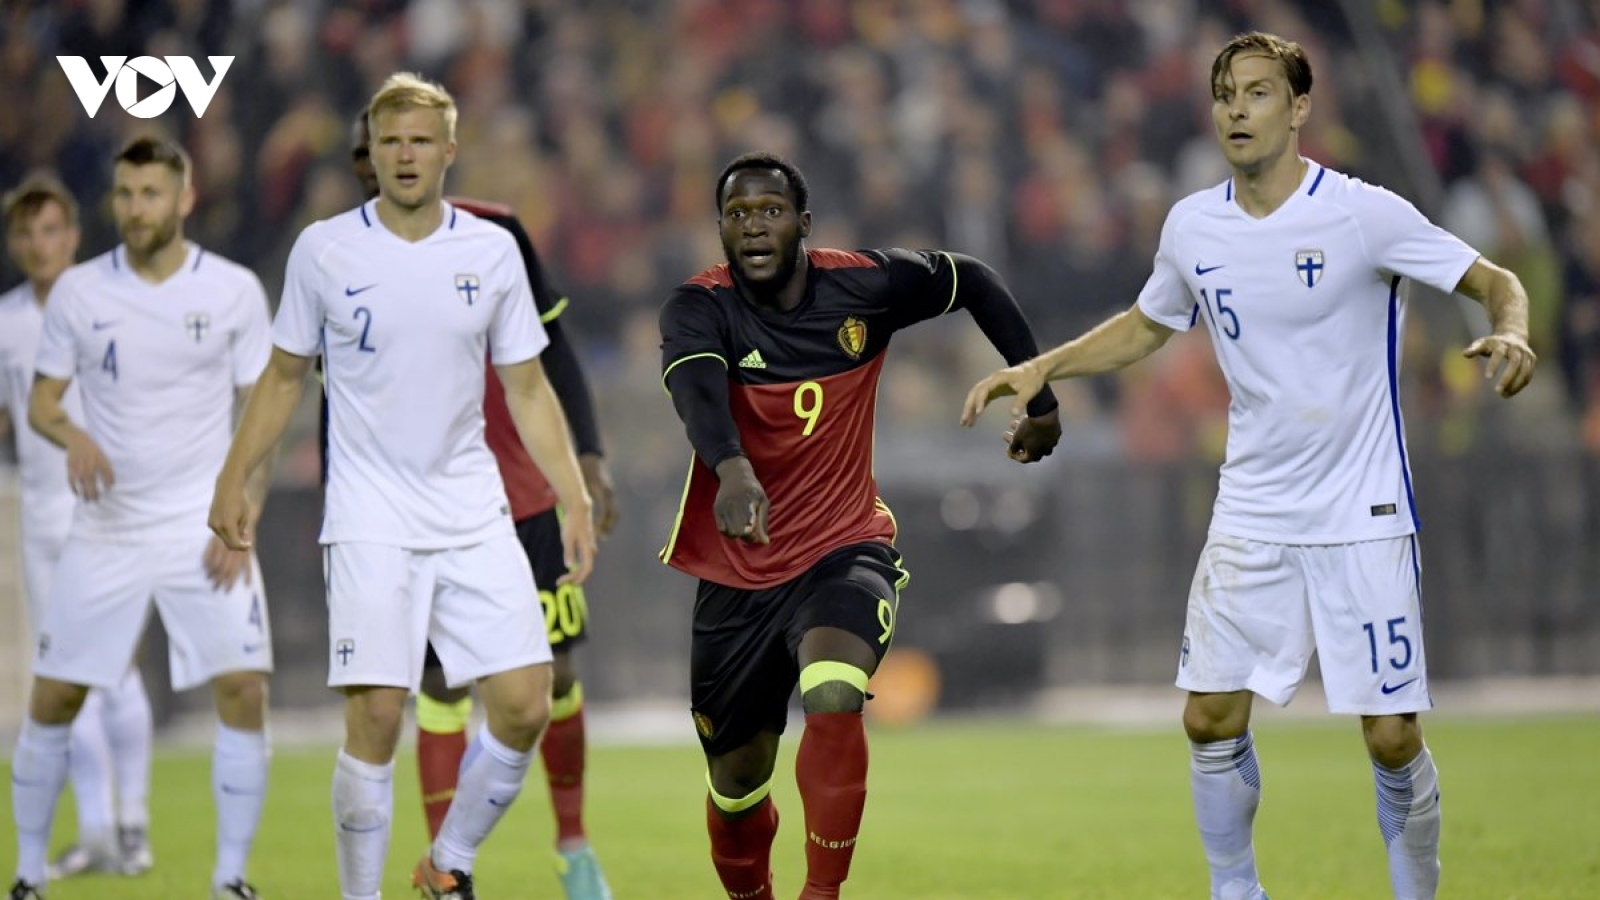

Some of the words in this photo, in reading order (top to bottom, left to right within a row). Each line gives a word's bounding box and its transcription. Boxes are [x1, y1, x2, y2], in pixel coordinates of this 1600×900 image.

[353, 306, 376, 353] 2
[1199, 288, 1241, 340] 15
[102, 339, 119, 382] 4
[738, 359, 767, 369] adidas
[793, 381, 824, 436] 9
[248, 593, 264, 635] 4
[537, 584, 582, 643] 20
[876, 598, 893, 644] 9
[1363, 616, 1412, 674] 15
